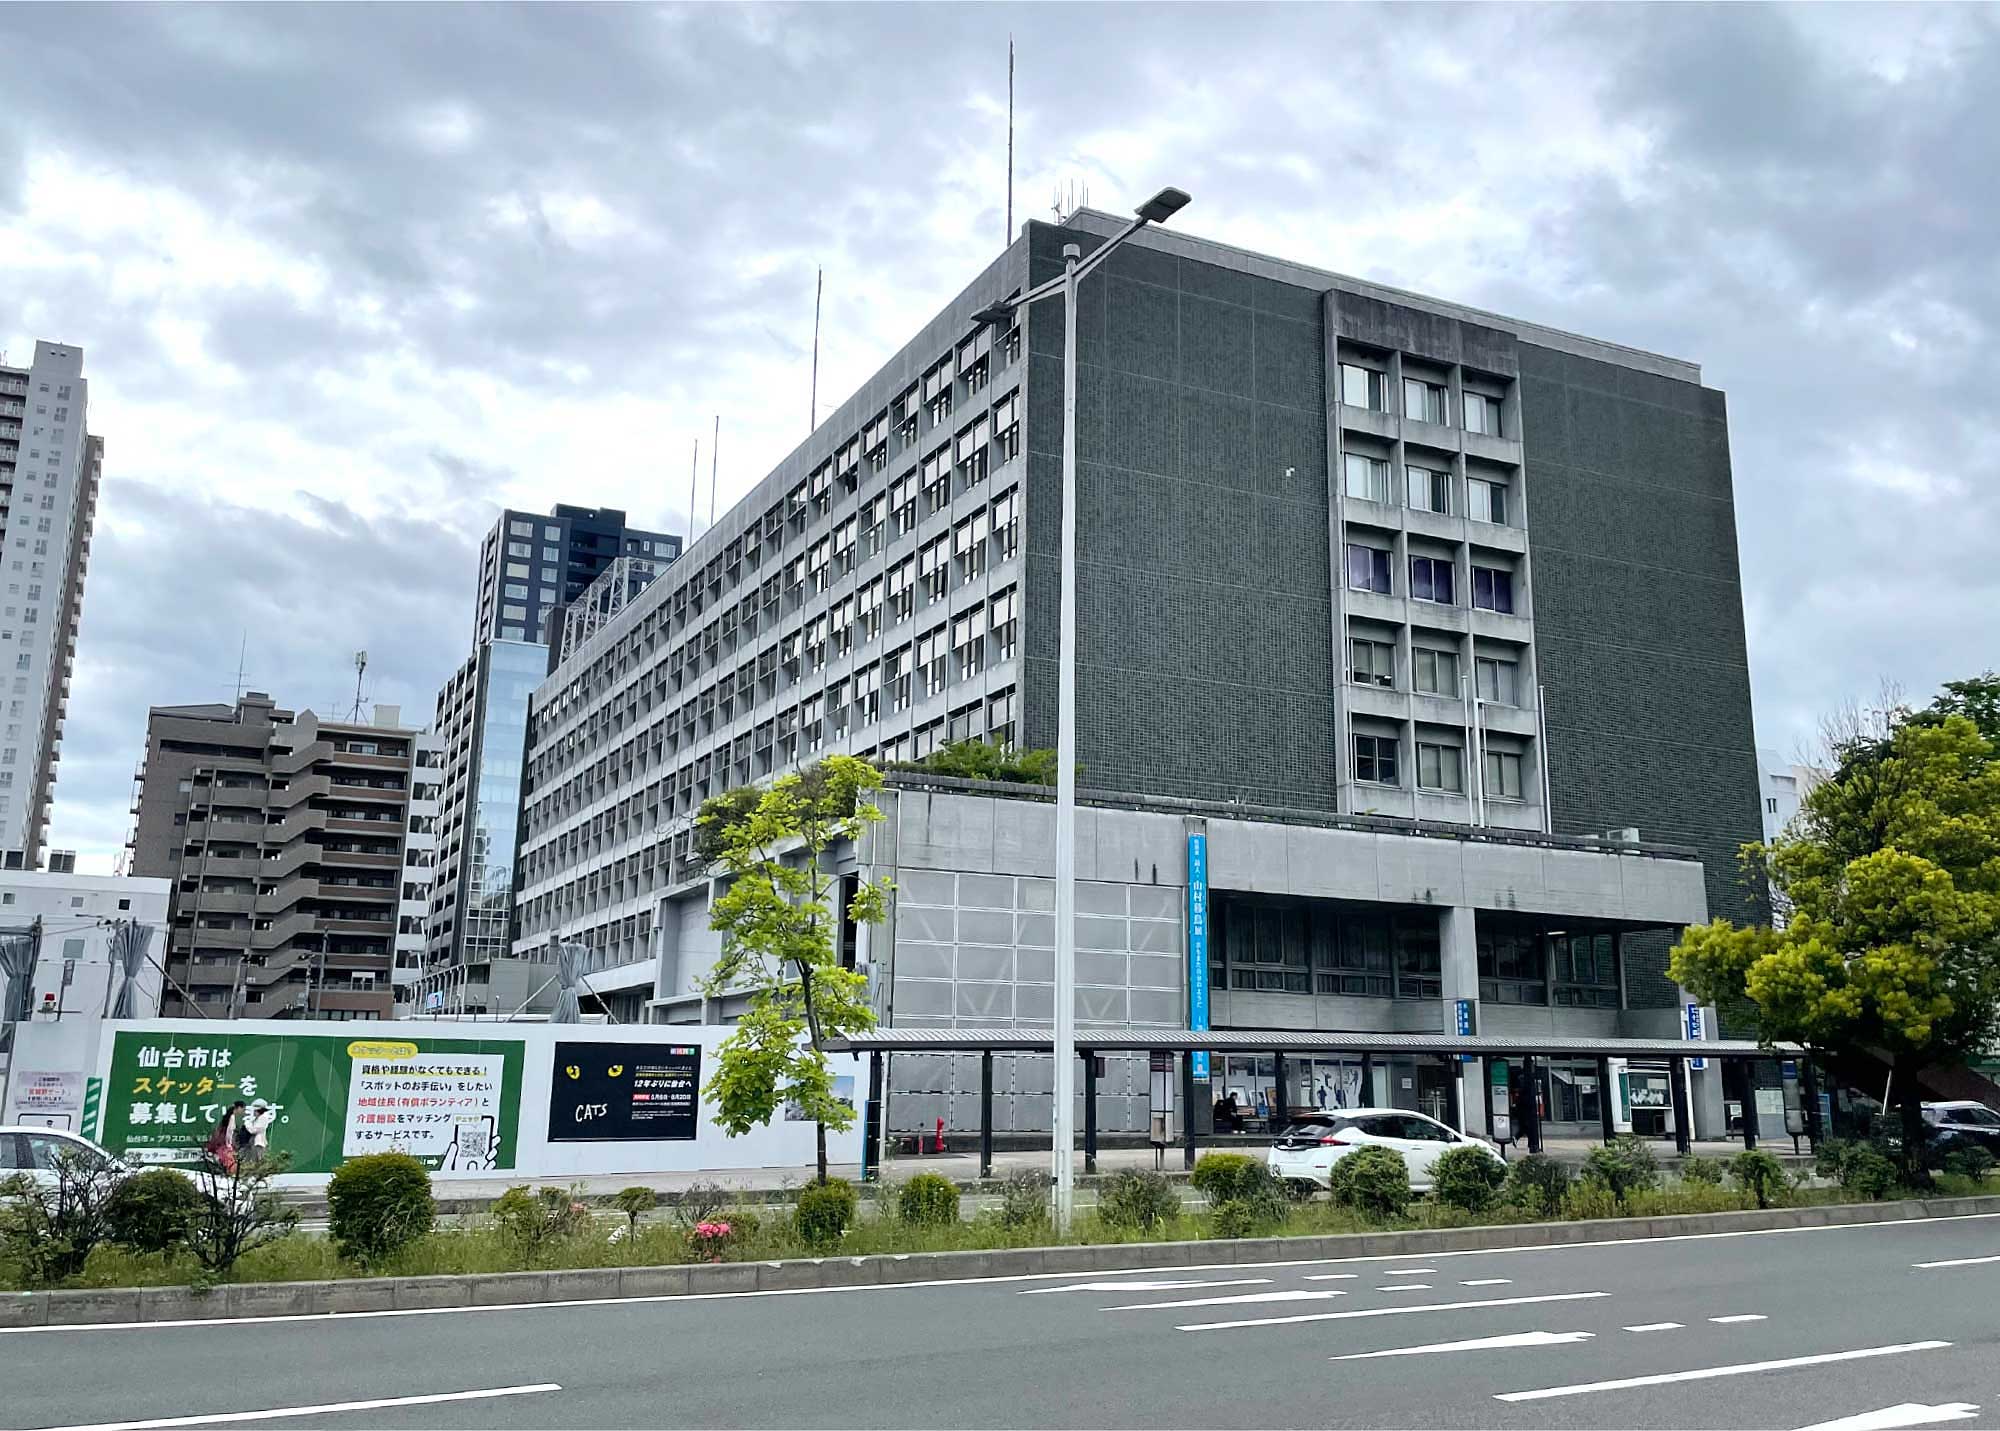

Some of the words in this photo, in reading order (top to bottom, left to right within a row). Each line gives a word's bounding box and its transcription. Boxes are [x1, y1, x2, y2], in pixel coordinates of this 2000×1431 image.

[137, 1046, 232, 1068] 仙台市は
[132, 1075, 258, 1096] スケッターを
[575, 1103, 608, 1123] CATS
[355, 1130, 435, 1140] するサービスです。
